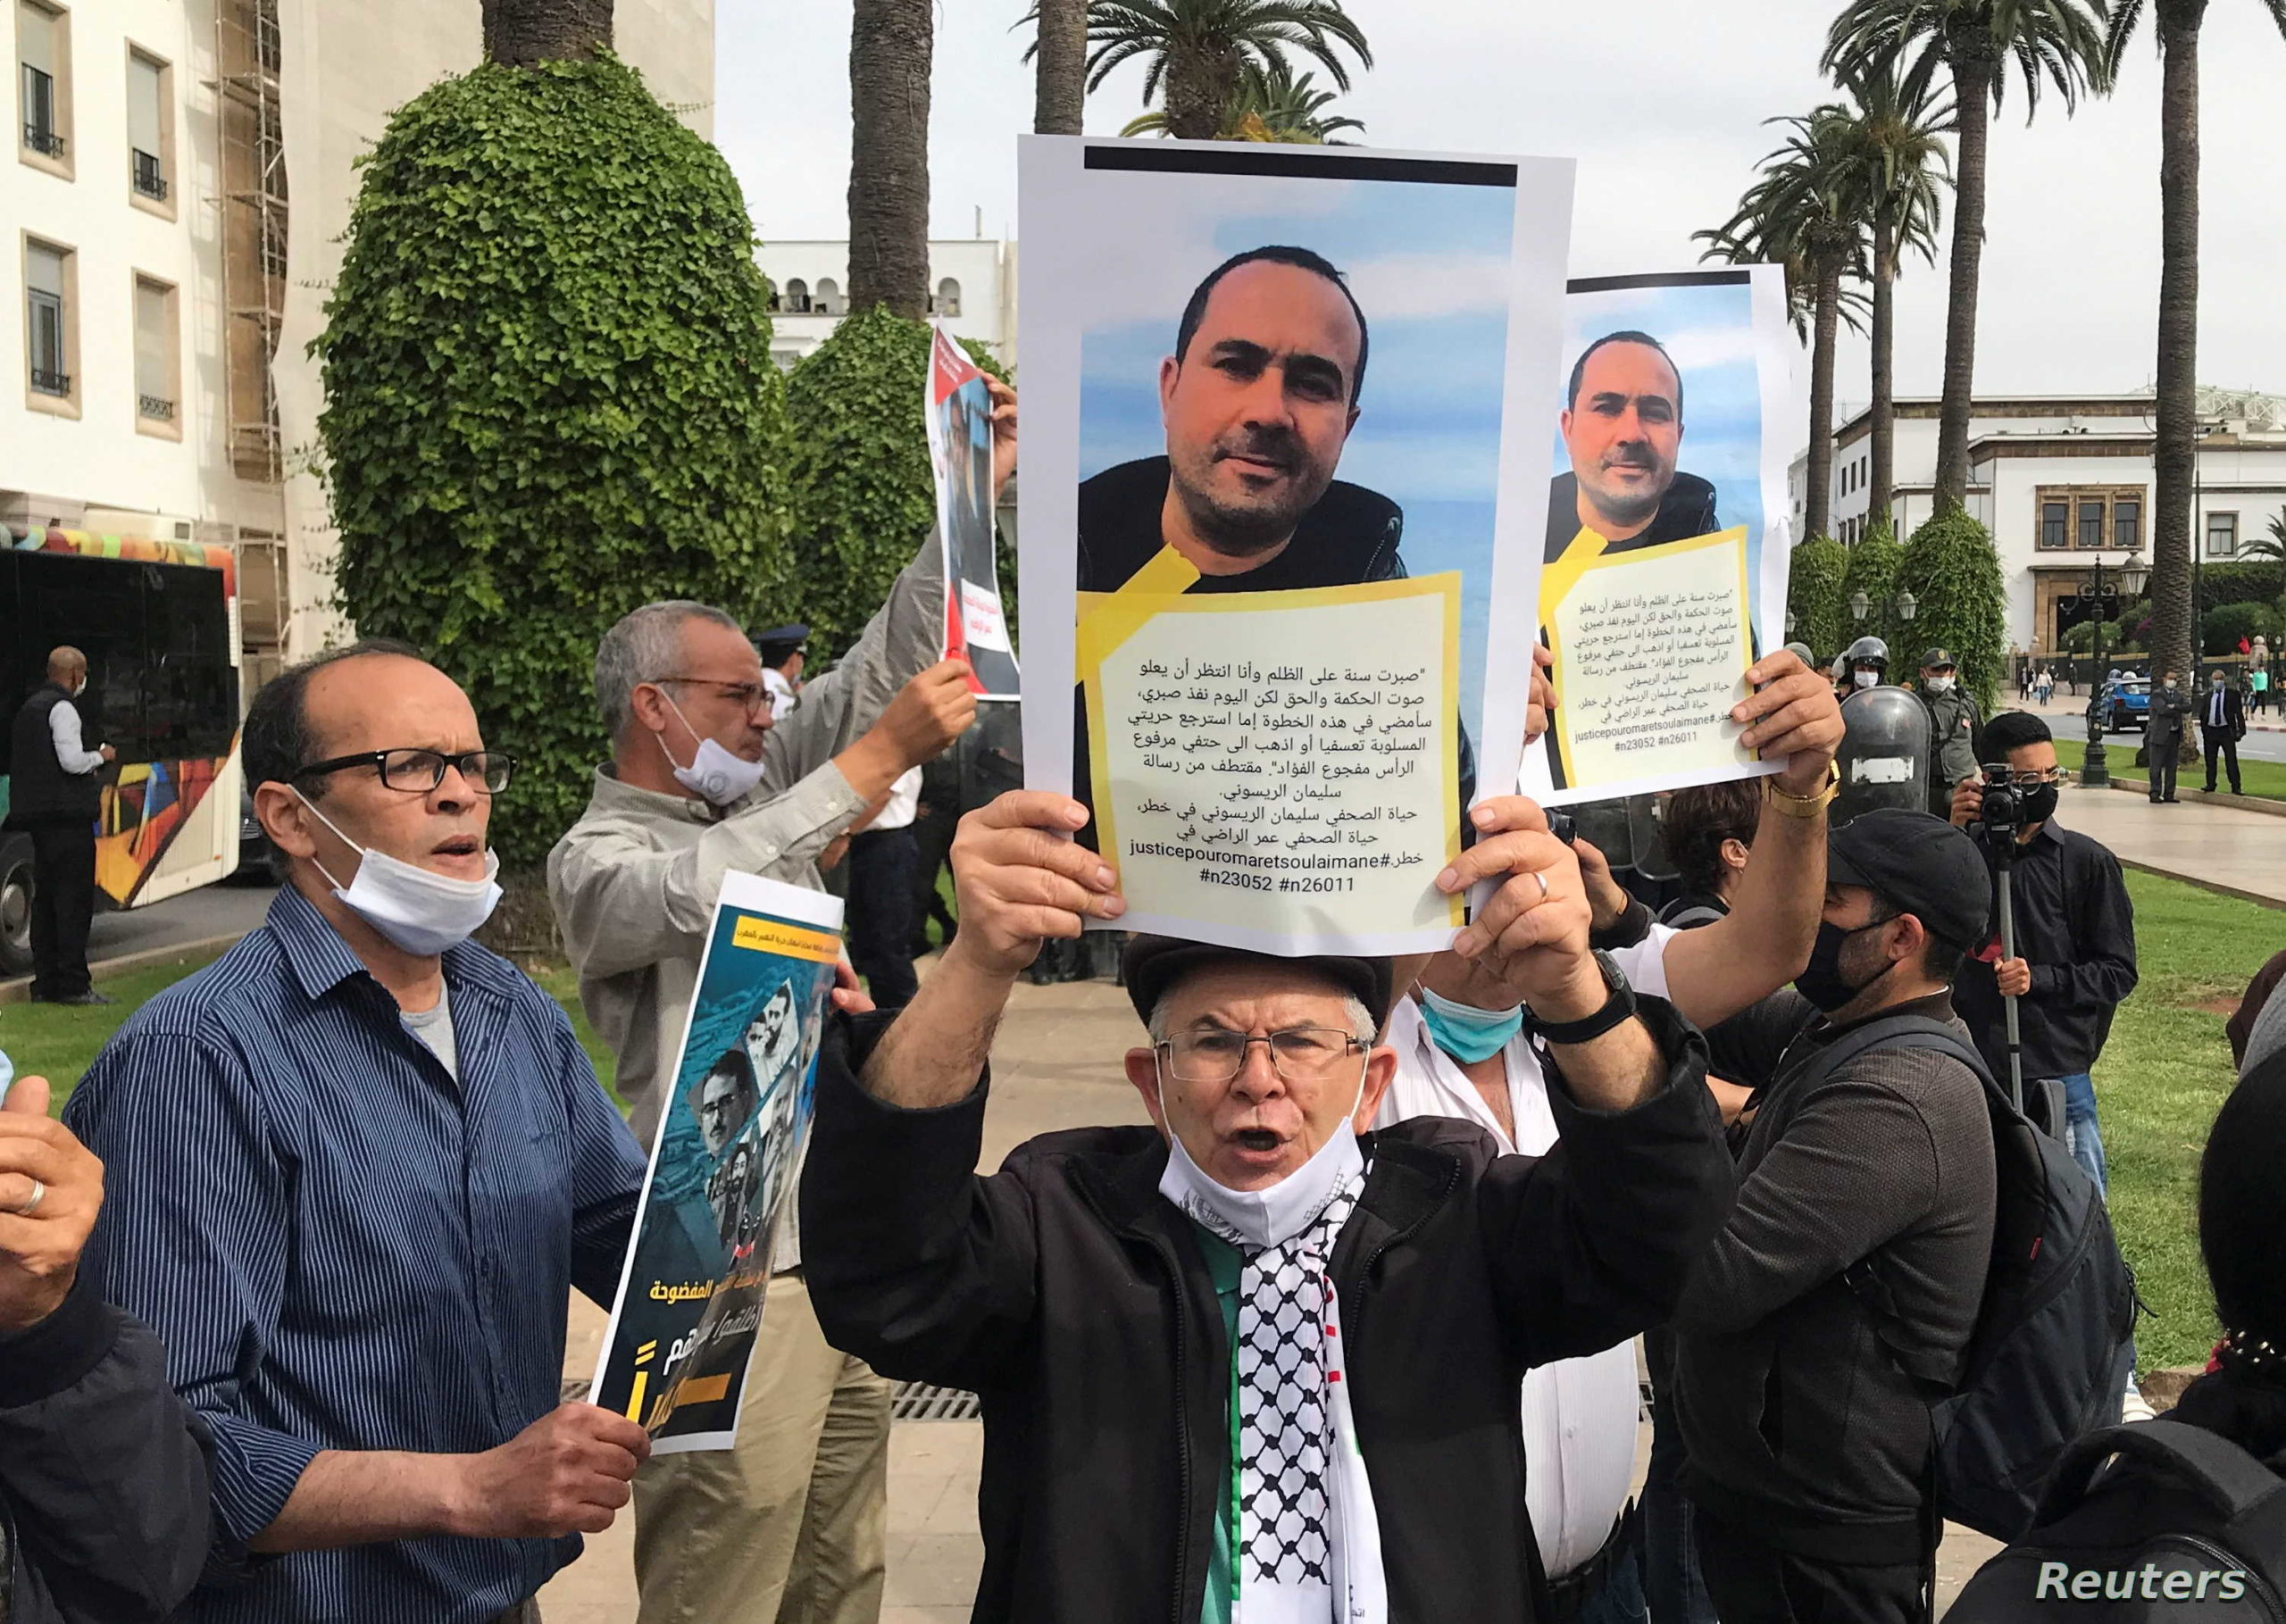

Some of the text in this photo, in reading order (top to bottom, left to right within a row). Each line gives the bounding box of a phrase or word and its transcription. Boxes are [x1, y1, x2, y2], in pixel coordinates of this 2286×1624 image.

[1140, 660, 1167, 677] يعلو
[1174, 658, 1188, 679] أن
[1195, 662, 1231, 679] انتظر
[1239, 662, 1260, 682] وأنا
[1268, 666, 1303, 685] الظلم
[1310, 668, 1337, 686] على
[1345, 669, 1371, 680] سنة
[1187, 687, 1207, 699] نفذ
[1214, 688, 1247, 705] اليوم
[1255, 690, 1278, 707] لكن
[1284, 691, 1327, 708] والحق
[1334, 691, 1380, 704] الحكمة
[1388, 694, 1424, 708] صوت
[1128, 711, 1431, 734] سأمضي في هذه الخطوة إما استرجع حريتي
[1134, 731, 1425, 754] المسلوبة تعسفيا أو اذهب الى حتفي مرفوع
[1615, 732, 1696, 752] #n23052 #n26011
[1144, 754, 1180, 772] رسالة
[1186, 764, 1205, 774] من
[1212, 759, 1261, 773] مقتطف
[1322, 763, 1369, 779] مفجوع
[1376, 758, 1414, 779] الرأس
[1293, 784, 1341, 802] سليمان
[1177, 803, 1196, 820] في
[1202, 806, 1264, 823] الريسوني
[1271, 807, 1319, 824] سليمان
[1326, 807, 1381, 827] الصحفي
[1389, 806, 1417, 822] حياة
[1177, 825, 1378, 850] حياة الصحفي عمر الراضي في
[1199, 868, 1354, 892] #n23052 #n26011
[650, 1279, 713, 1304] المفضوحة
